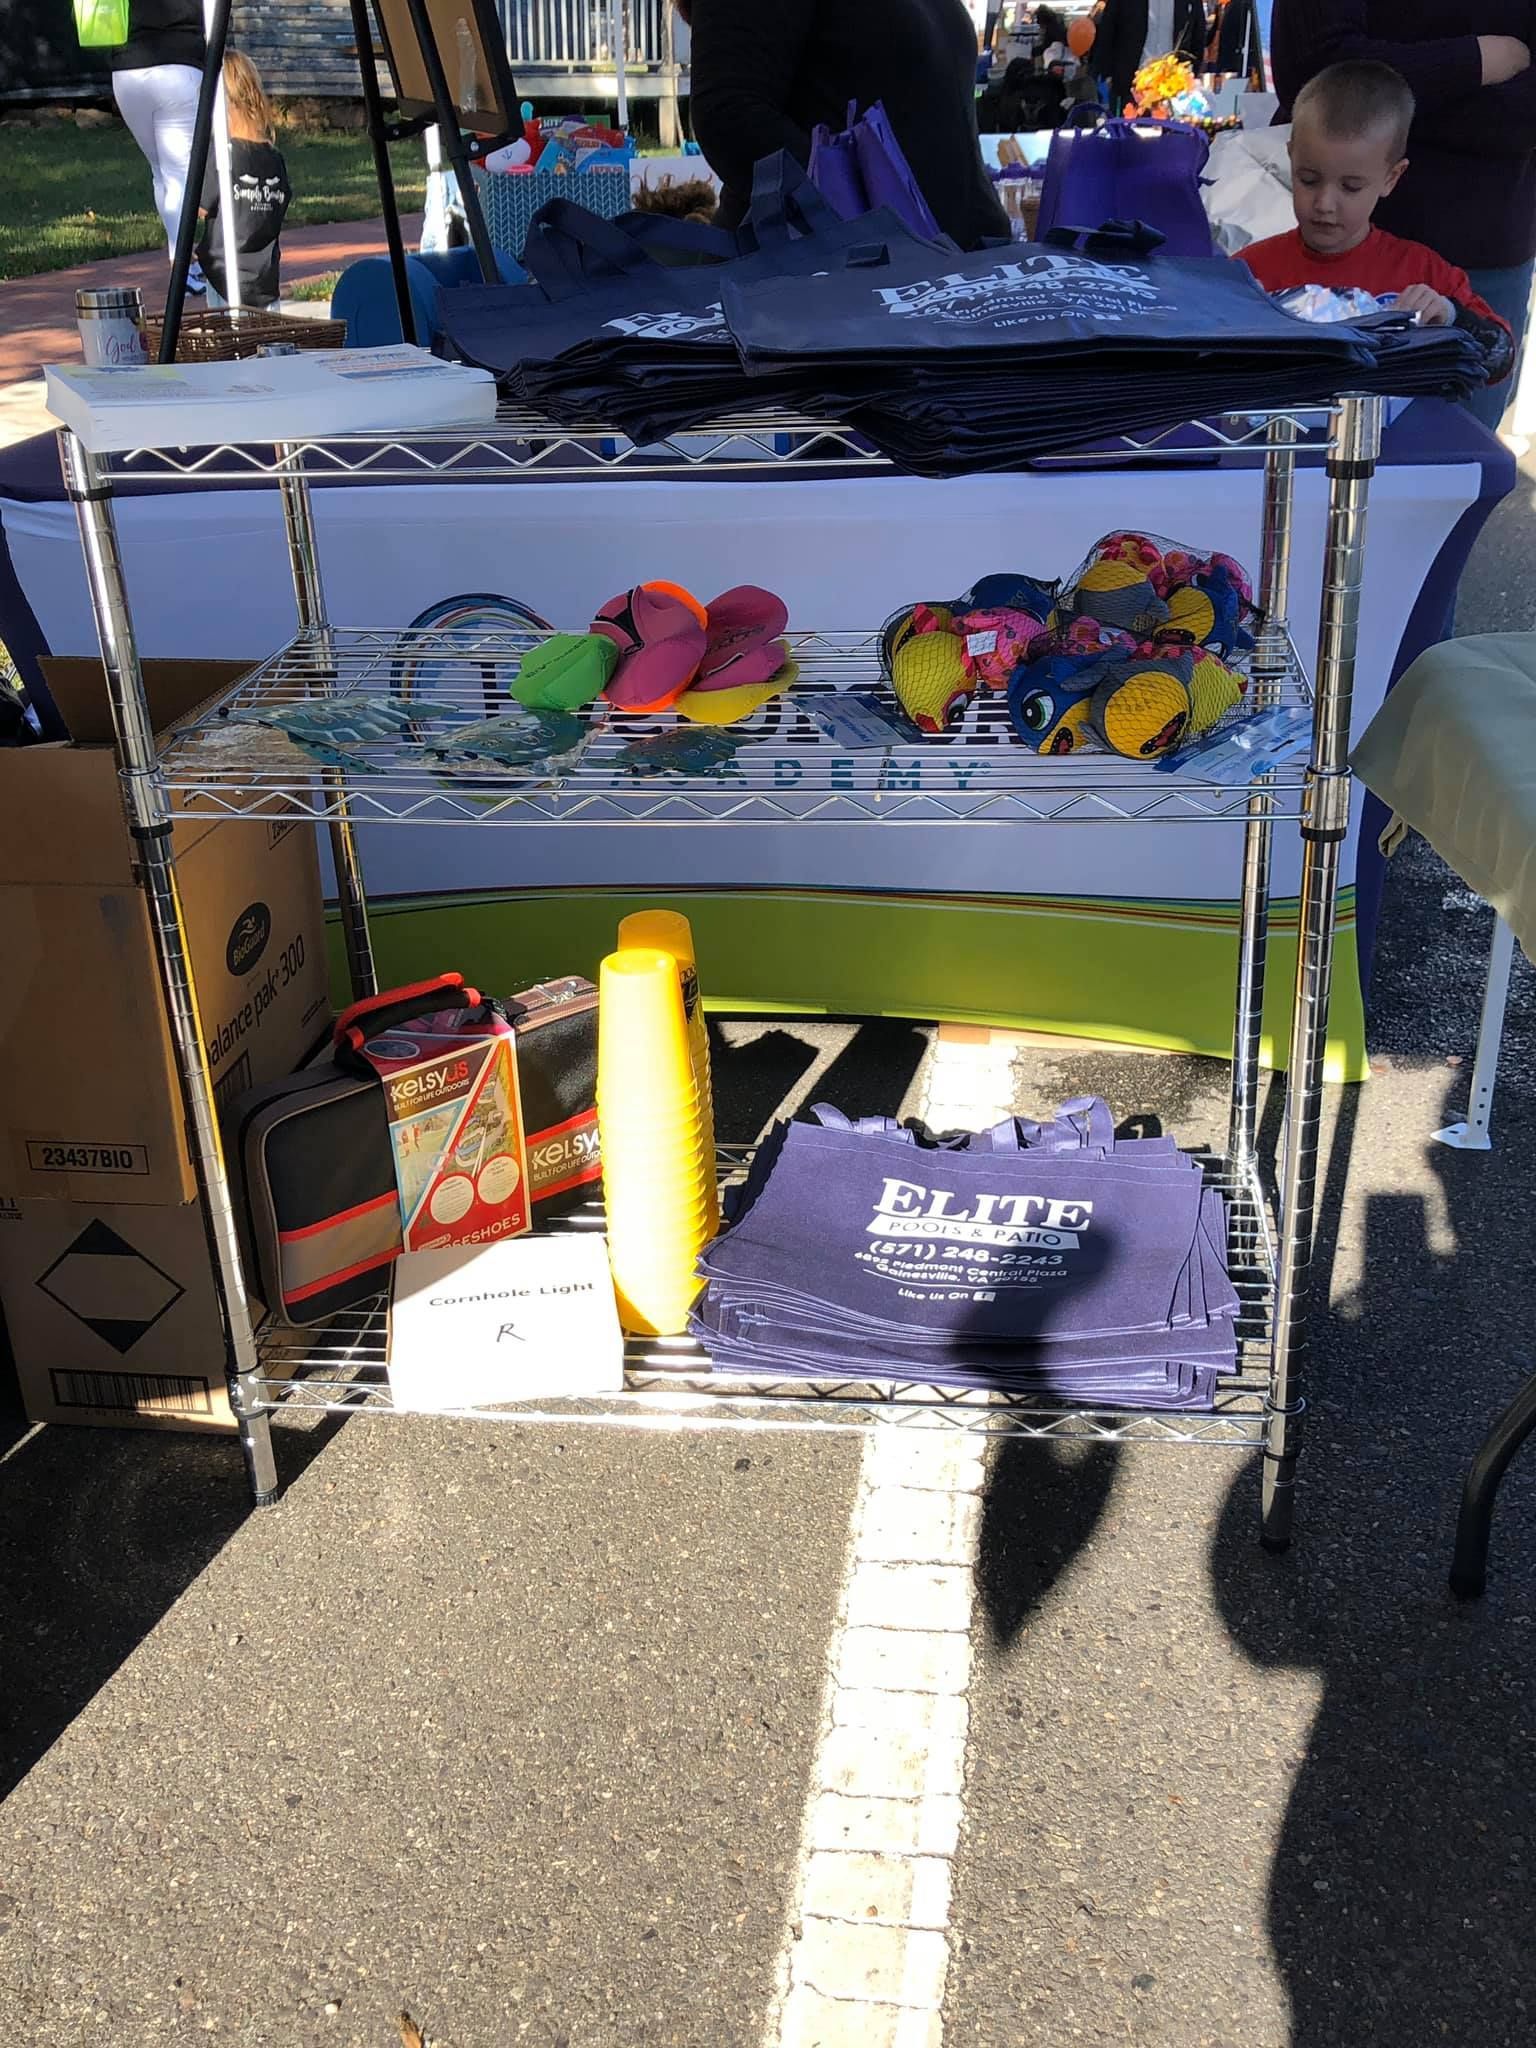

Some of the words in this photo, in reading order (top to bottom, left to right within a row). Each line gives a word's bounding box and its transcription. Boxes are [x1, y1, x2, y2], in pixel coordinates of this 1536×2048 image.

[994, 316, 1030, 328] Like
[280, 933, 305, 987] 300
[873, 1178, 1093, 1231] ELITE
[889, 1221, 962, 1236] POOLS
[970, 1227, 984, 1238] &
[994, 1229, 1062, 1246] PATIO
[869, 1240, 936, 1261] (571)
[941, 1245, 1064, 1266] 248-2243
[893, 1260, 964, 1274] Piedmont
[966, 1267, 1023, 1278] Central
[1026, 1269, 1068, 1277] Plaza
[967, 1275, 989, 1285] VA
[429, 1288, 531, 1307] Cornhole
[540, 1282, 596, 1296] Light
[898, 1287, 926, 1300] Like
[929, 1292, 945, 1300] Us
[948, 1291, 969, 1300] On
[496, 1323, 527, 1343] R
